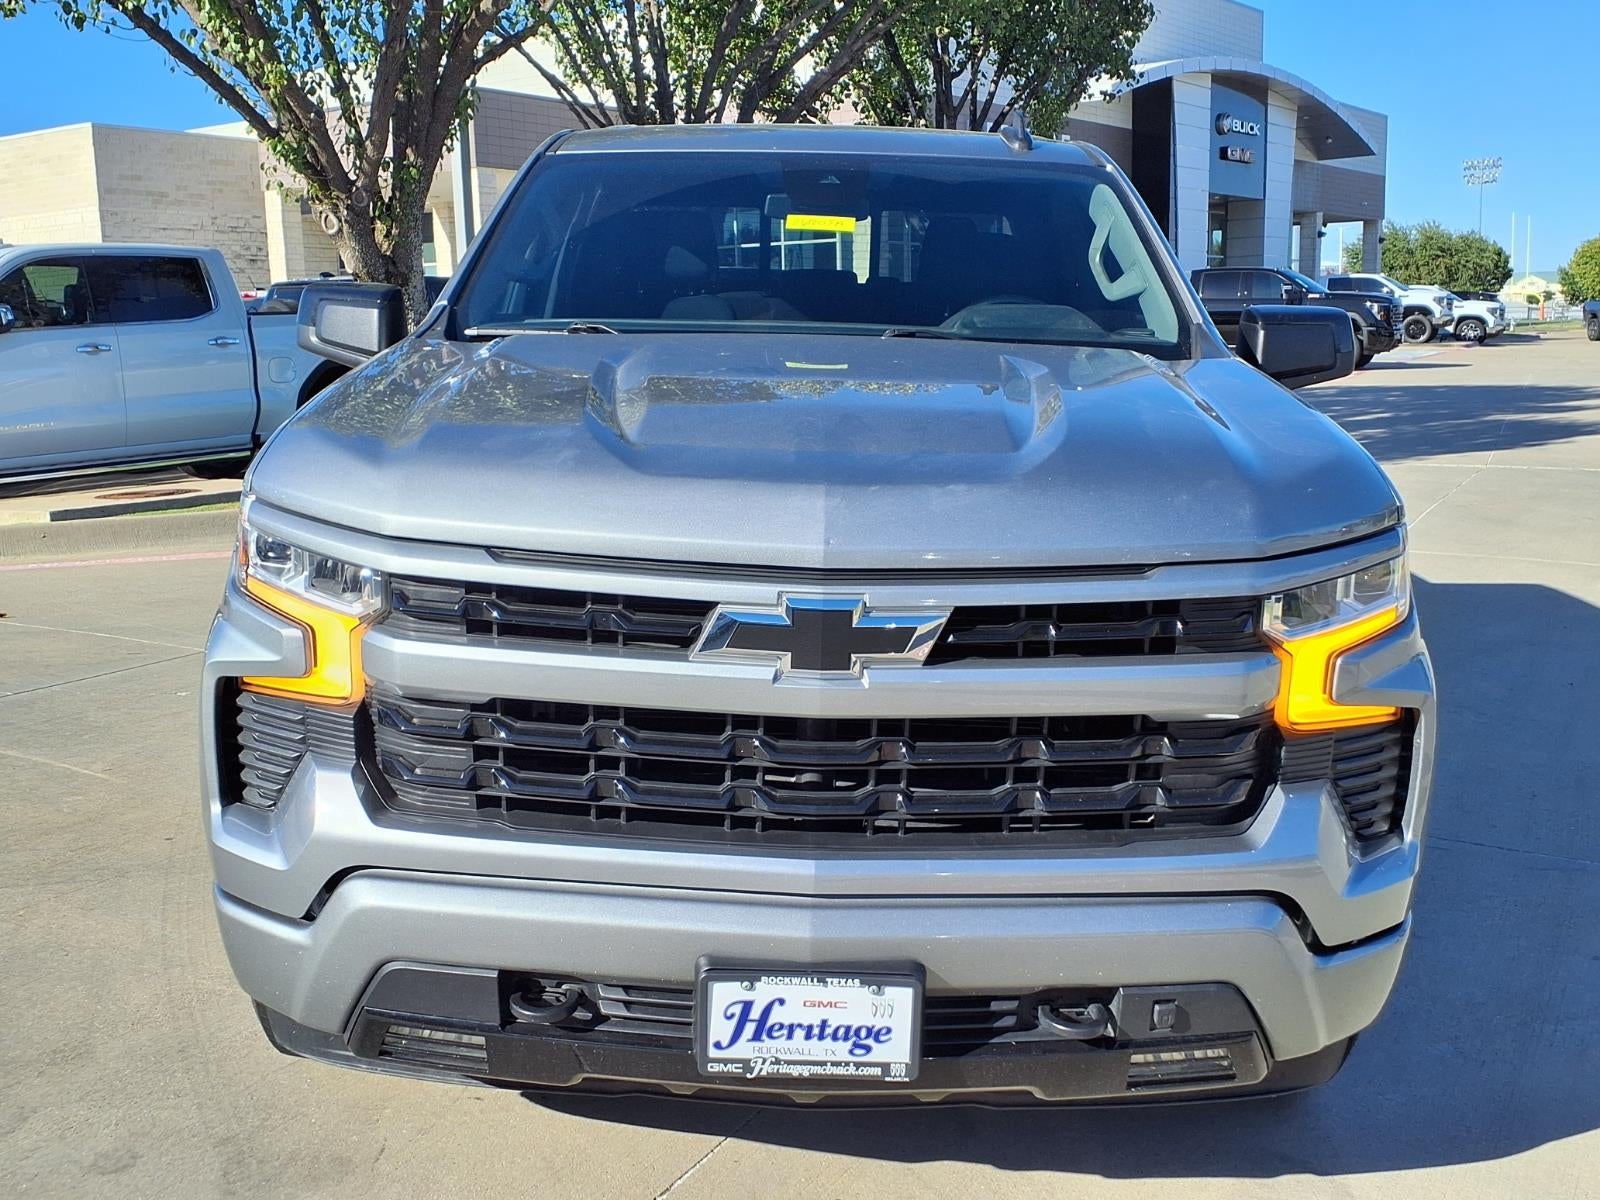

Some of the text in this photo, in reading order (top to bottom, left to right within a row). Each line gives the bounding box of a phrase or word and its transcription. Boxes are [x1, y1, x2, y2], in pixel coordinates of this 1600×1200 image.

[1232, 119, 1260, 136] BUICK
[825, 977, 861, 987] TEXAS
[802, 1000, 848, 1010] GMC
[712, 997, 893, 1058] Heritage
[824, 1047, 838, 1058] TX
[707, 1055, 882, 1079] GMC Heritagegmcbuick.com
